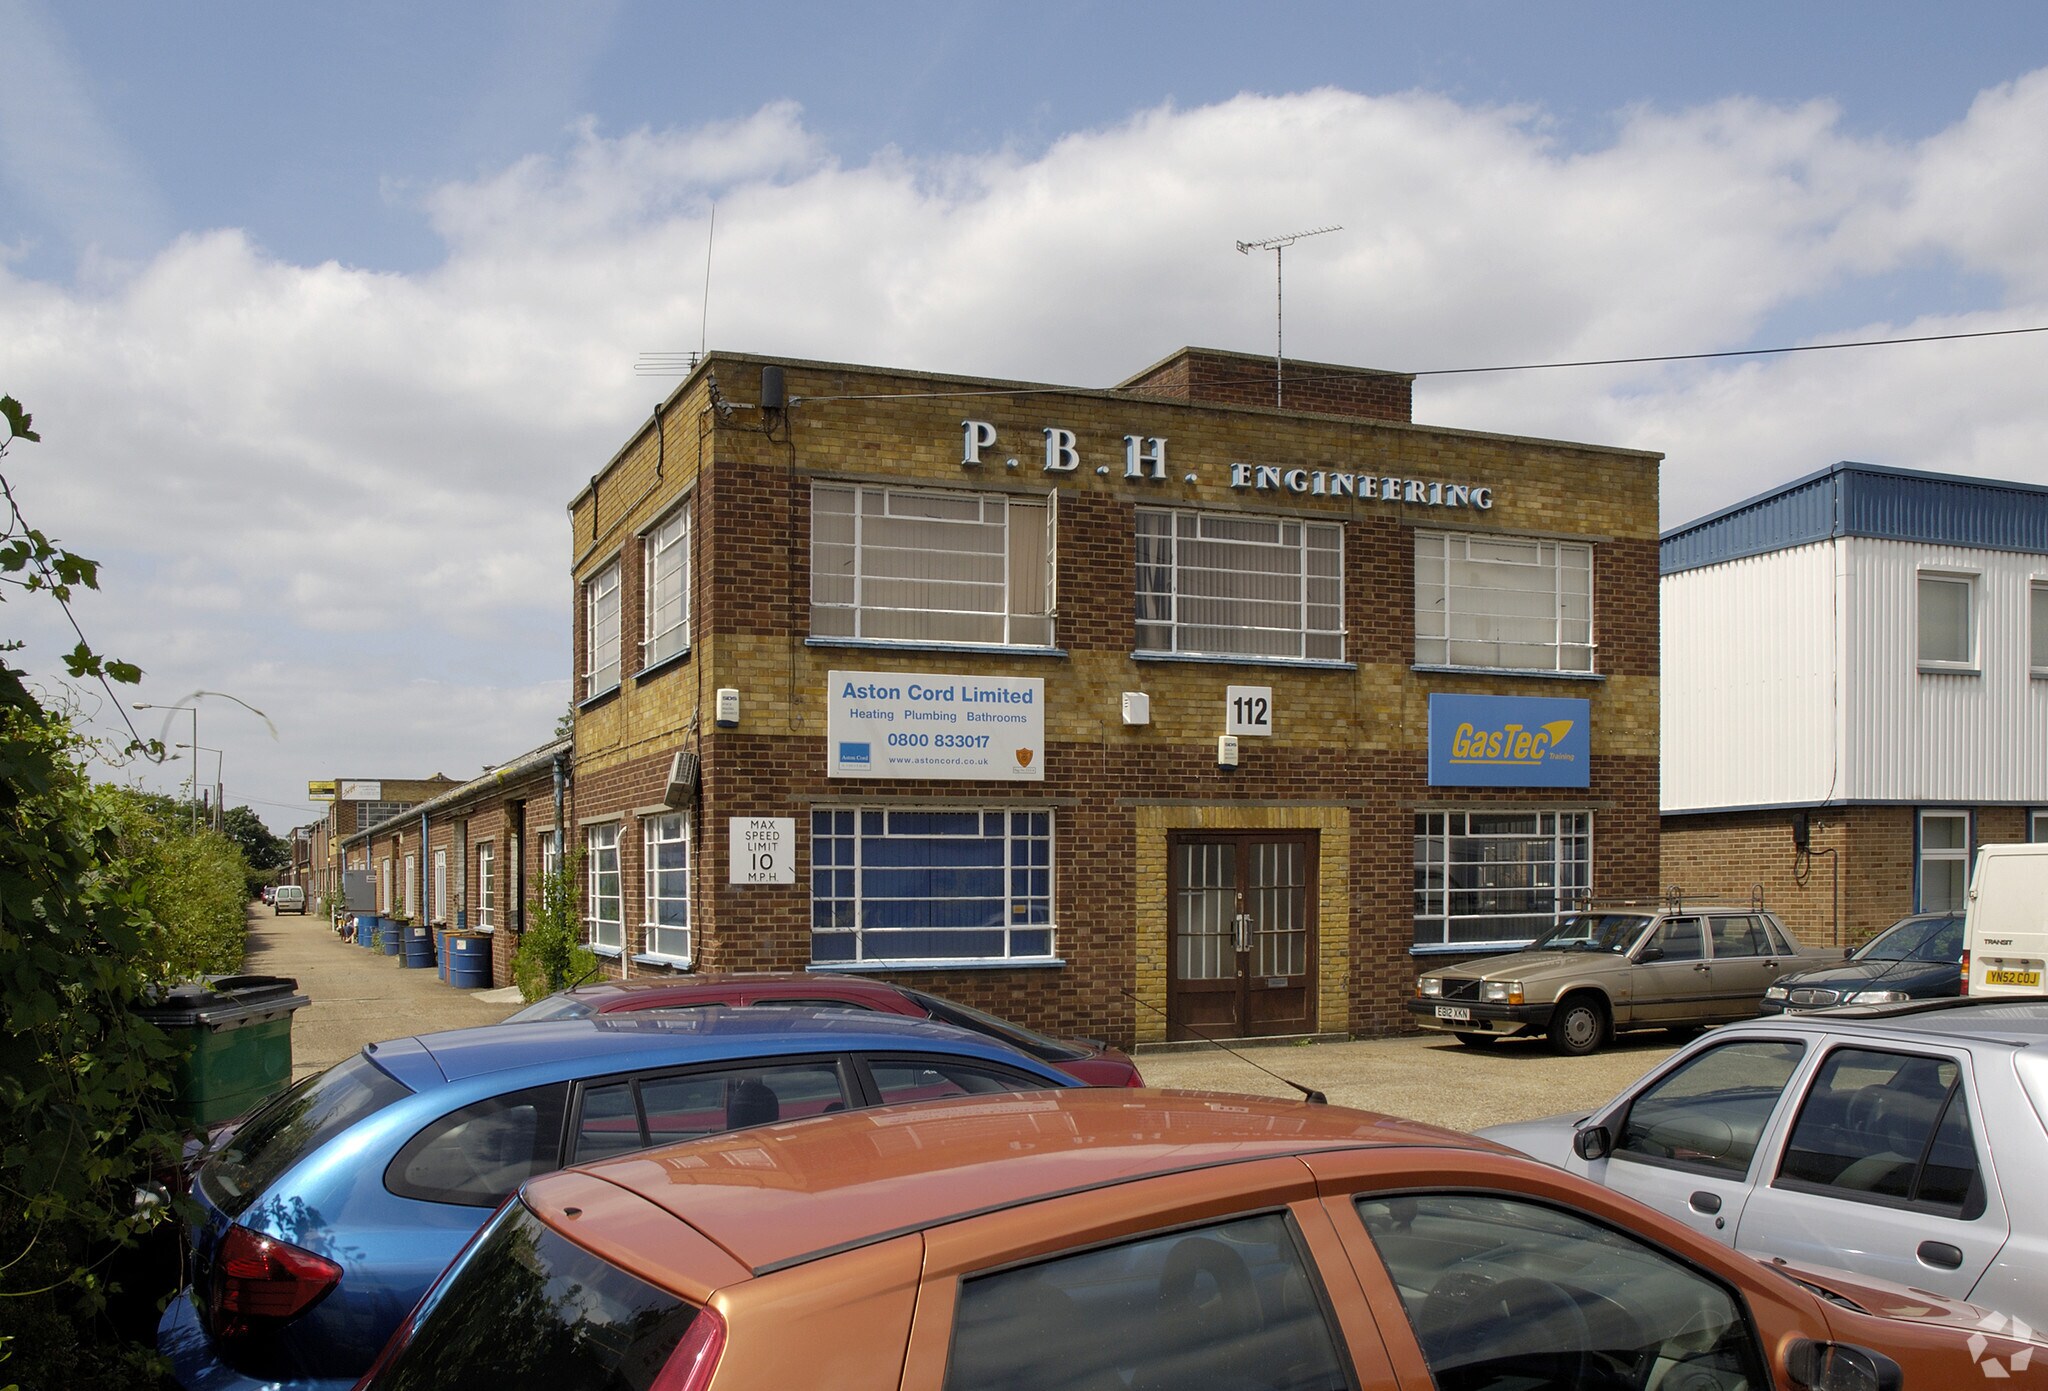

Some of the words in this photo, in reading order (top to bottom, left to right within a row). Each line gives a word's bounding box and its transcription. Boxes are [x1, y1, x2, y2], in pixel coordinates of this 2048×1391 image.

[1230, 461, 1494, 511] ENGINEERING
[842, 682, 901, 701] Aston
[907, 684, 955, 702] Cord
[962, 686, 1034, 704] Limited
[849, 708, 895, 721] Heating
[904, 710, 957, 723] Plumbing
[967, 711, 1028, 723] Bathrooms
[1233, 697, 1268, 725] 112
[887, 733, 929, 747] 0800
[934, 734, 990, 748] 833017
[1452, 722, 1549, 759] GasTec
[888, 756, 989, 766] www.astoncord.co.uk
[750, 820, 775, 830] MAX
[745, 831, 780, 841] SPEED
[747, 842, 778, 852] LIMIT
[751, 853, 774, 870] 10
[748, 872, 779, 882] M.P.H.
[1984, 938, 2013, 946] TRANSIT
[1991, 971, 2016, 983] YN52
[2017, 972, 2037, 984] COJ
